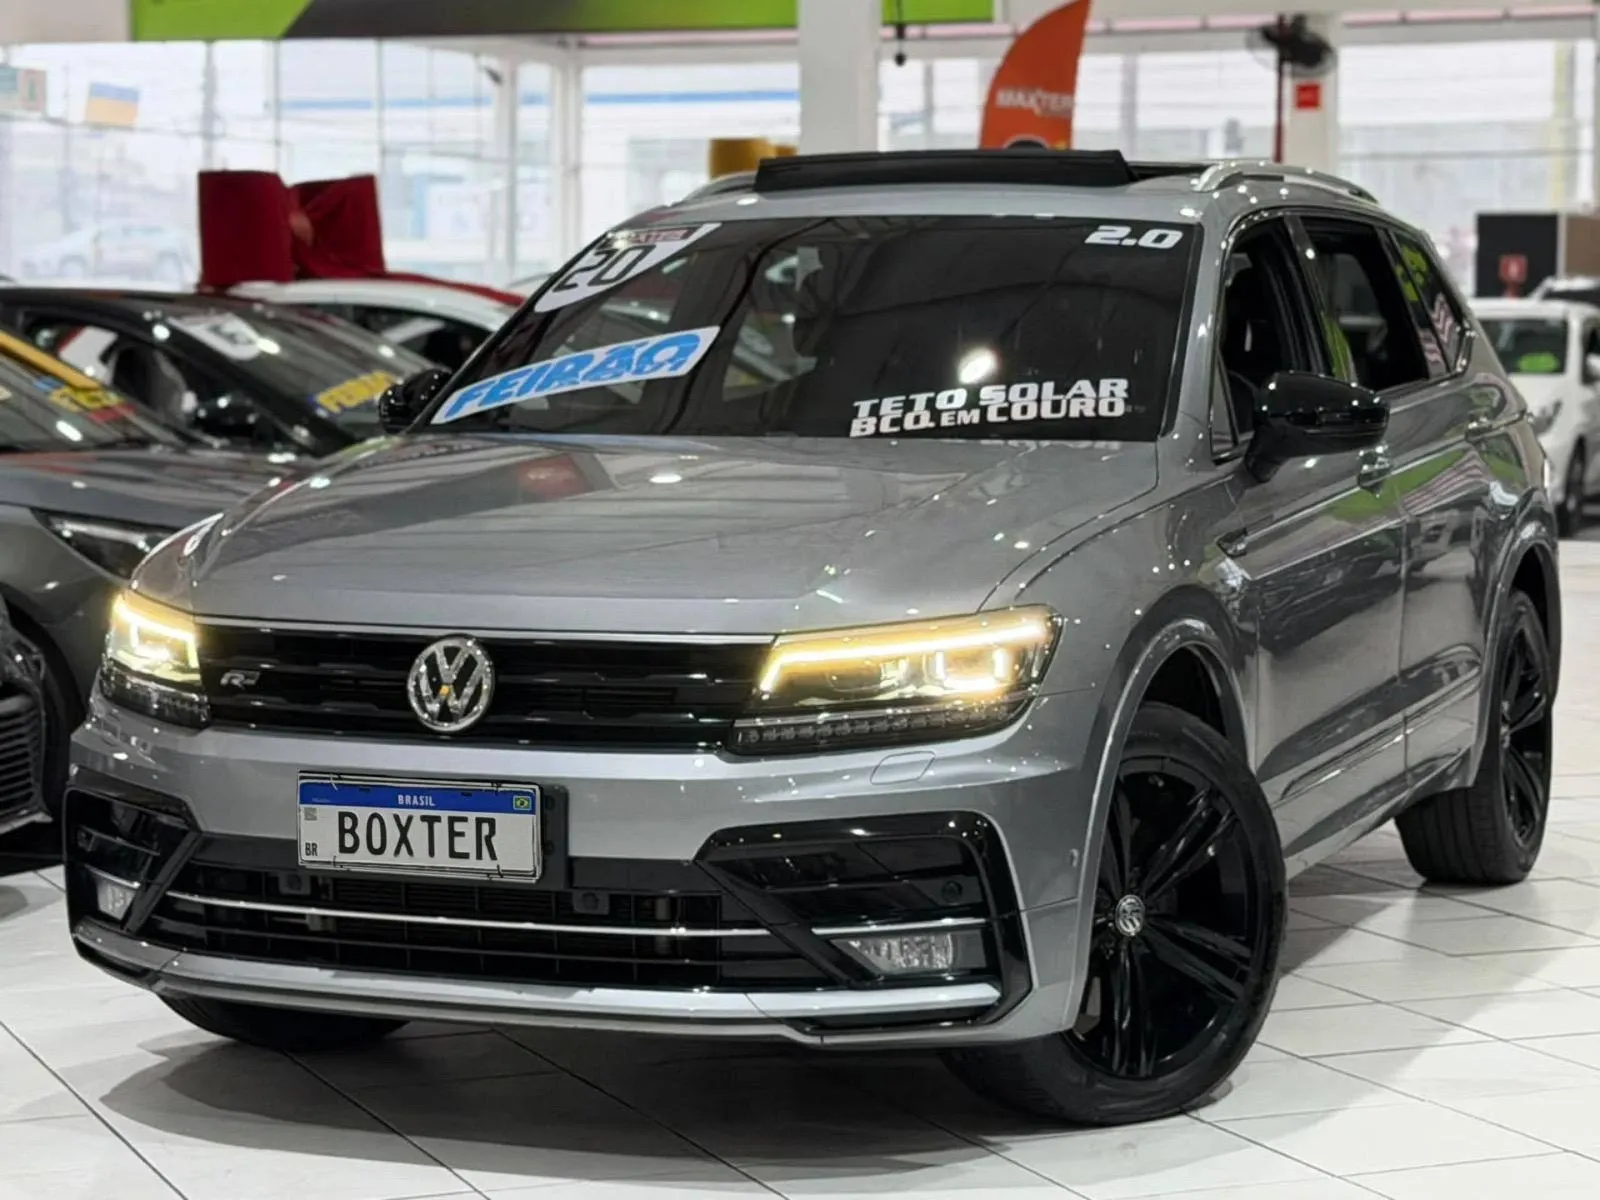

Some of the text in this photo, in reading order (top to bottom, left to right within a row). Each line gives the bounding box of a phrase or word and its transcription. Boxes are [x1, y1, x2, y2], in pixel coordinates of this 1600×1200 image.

[1084, 225, 1183, 249] 2.0
[551, 245, 656, 292] 20
[444, 333, 701, 418] FEIRÃO
[853, 378, 1129, 418] TETO SOLAR
[940, 408, 980, 427] EM
[986, 397, 1125, 422] COURO
[397, 794, 436, 807] BRASIL
[305, 842, 318, 857] BR
[338, 811, 498, 860] BOXTER
